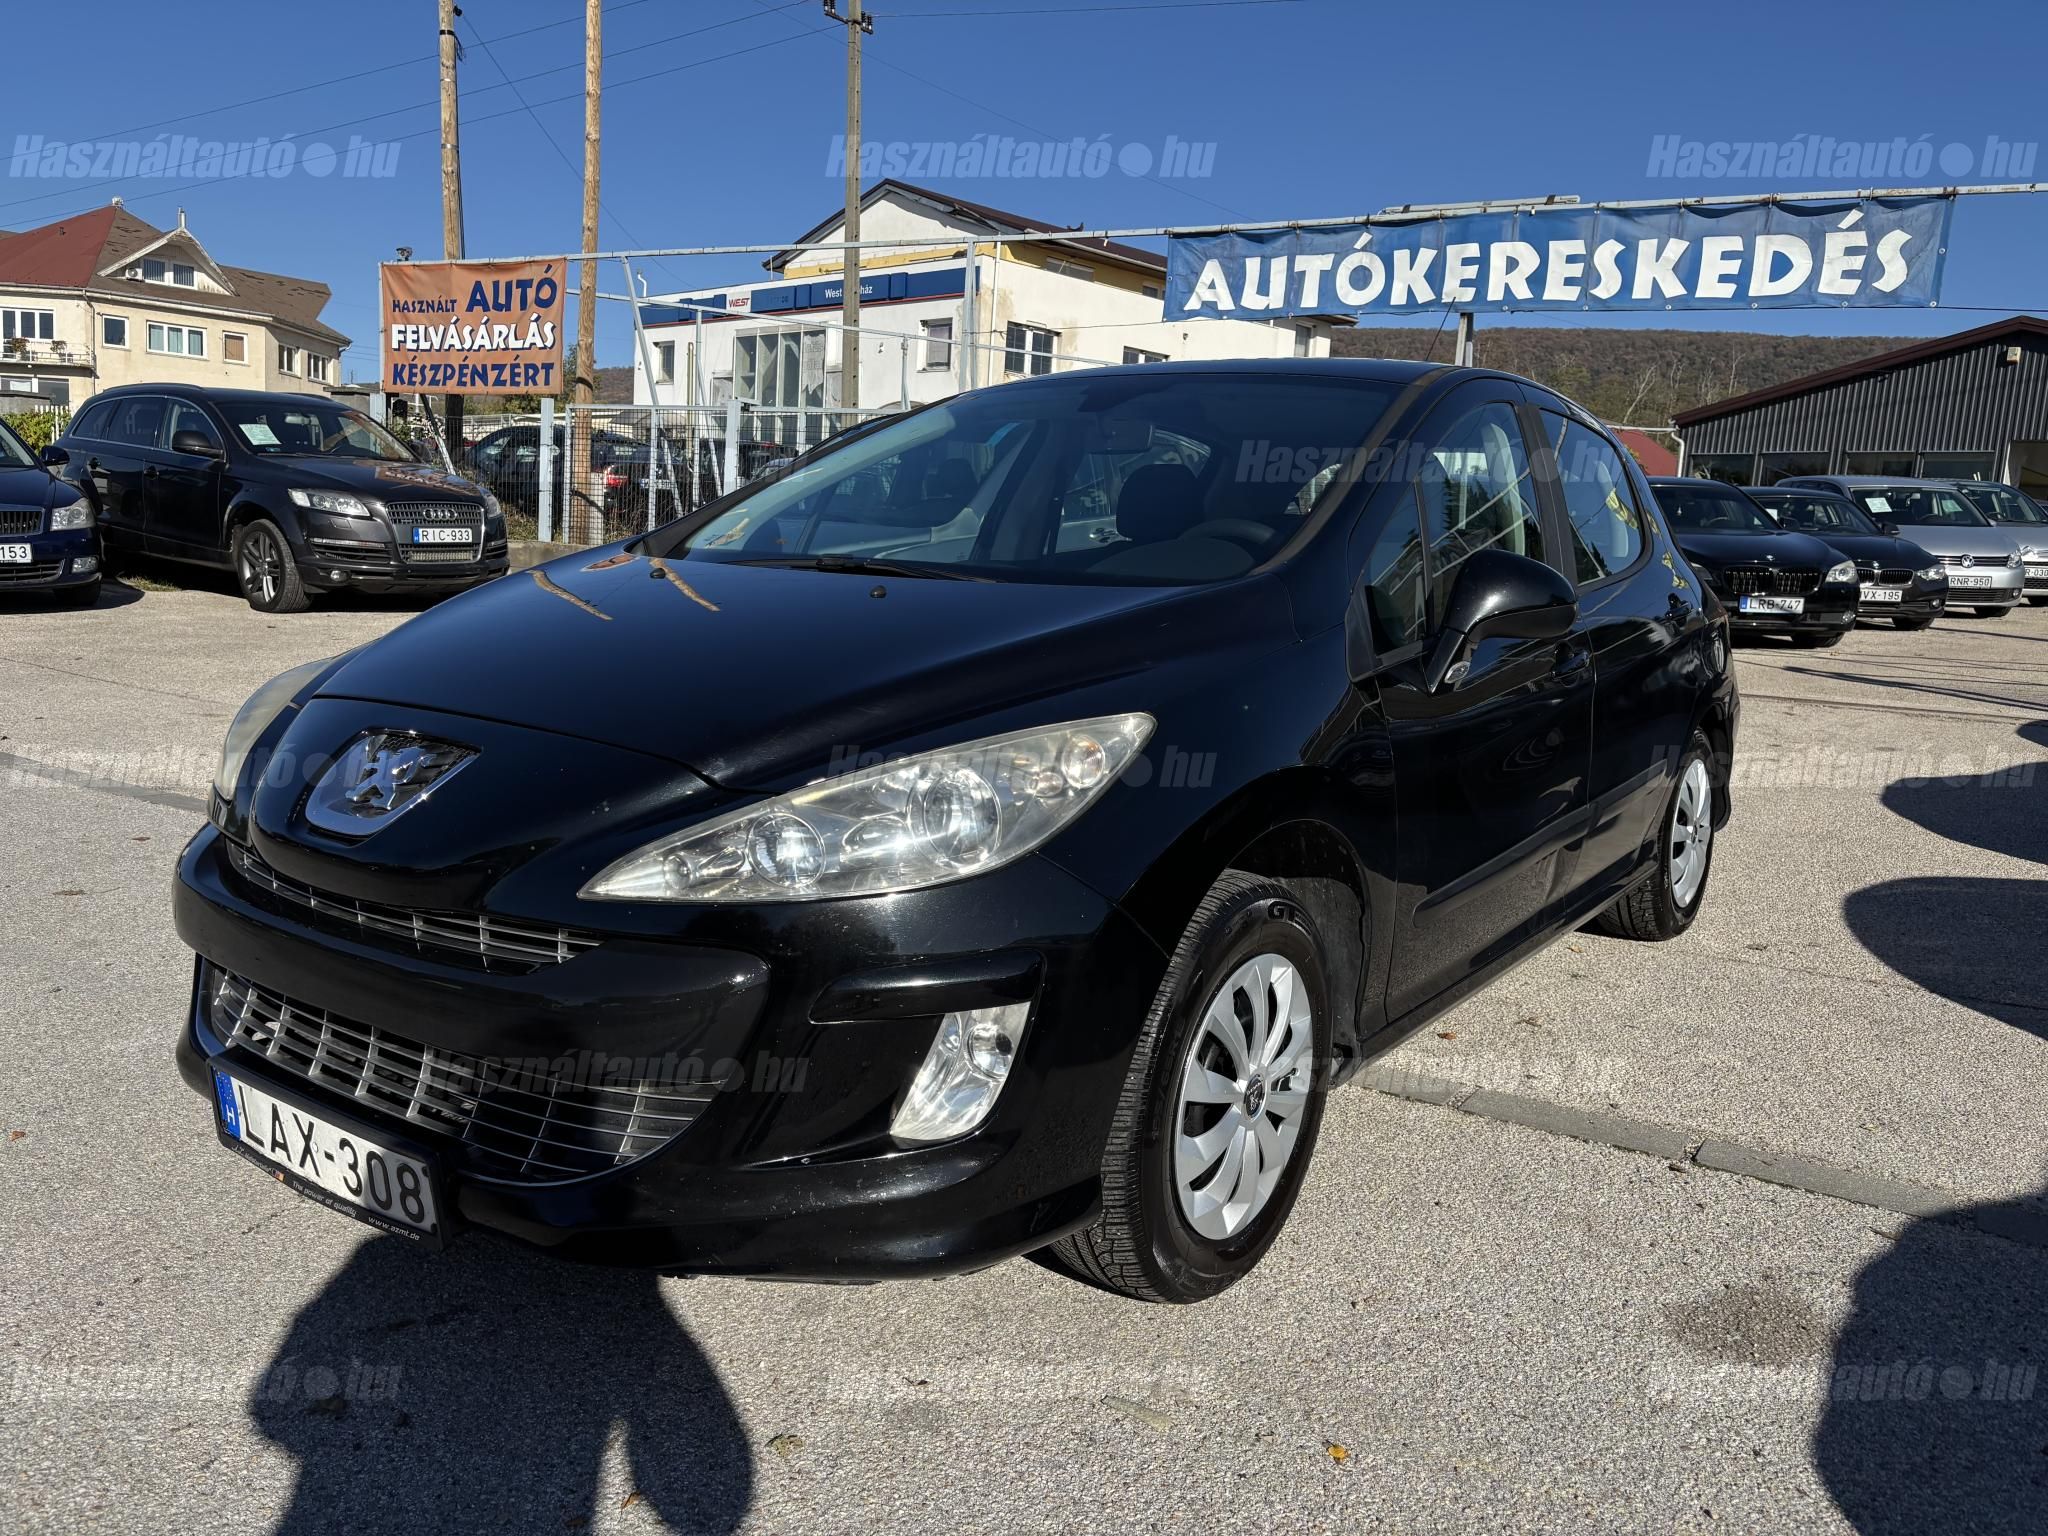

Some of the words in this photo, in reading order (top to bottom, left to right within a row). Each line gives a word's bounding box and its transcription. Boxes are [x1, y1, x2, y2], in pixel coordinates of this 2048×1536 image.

[1183, 209, 1913, 311] AUTÓKERESKEDÉS
[392, 295, 457, 313] HASZNÁLT
[465, 264, 558, 312] AUTÓ
[825, 288, 842, 298] West
[728, 297, 750, 308] WEST
[391, 312, 557, 352] FELVÁSÁRLÁS
[392, 354, 555, 388] KÉSZPÉNZÉRT
[421, 530, 470, 541] RIC-933
[0, 546, 28, 559] 153
[1950, 577, 1990, 586] RNR-950
[1860, 590, 1900, 601] VX-195
[1749, 598, 1801, 610] LRB-747
[238, 1084, 425, 1224] LAX-308
